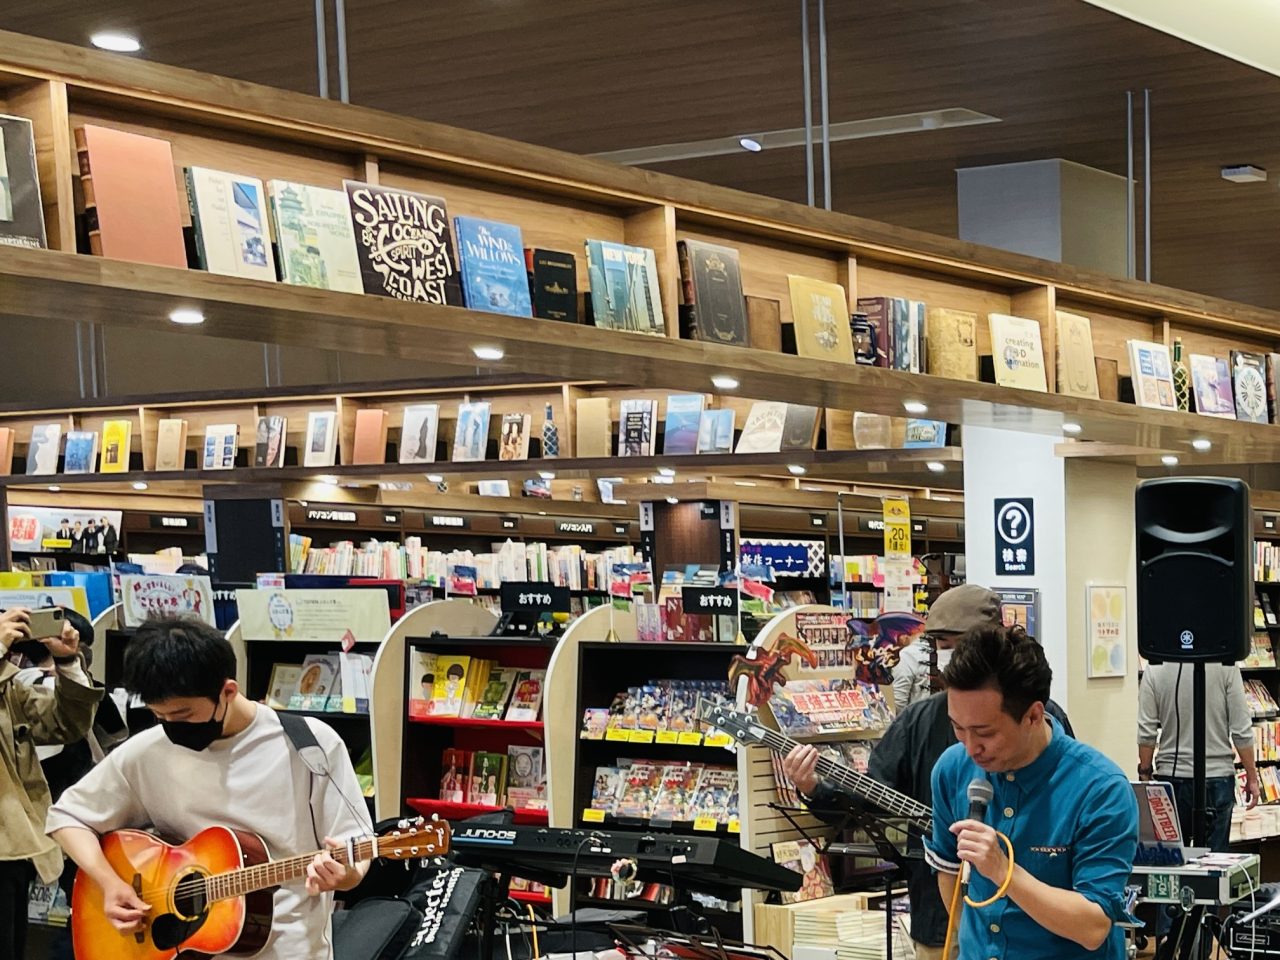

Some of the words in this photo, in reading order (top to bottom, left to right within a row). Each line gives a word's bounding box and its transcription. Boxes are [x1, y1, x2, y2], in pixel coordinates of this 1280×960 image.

[353, 189, 445, 236] SAILING
[391, 244, 416, 261] SPIRIT
[411, 242, 452, 280] WEST
[466, 240, 521, 266] WILLOWS
[389, 271, 447, 305] COAST
[1005, 337, 1035, 351] creating
[518, 592, 552, 606] おすすめ
[699, 594, 733, 608] おすすめ
[460, 828, 517, 840] JUNO-DS
